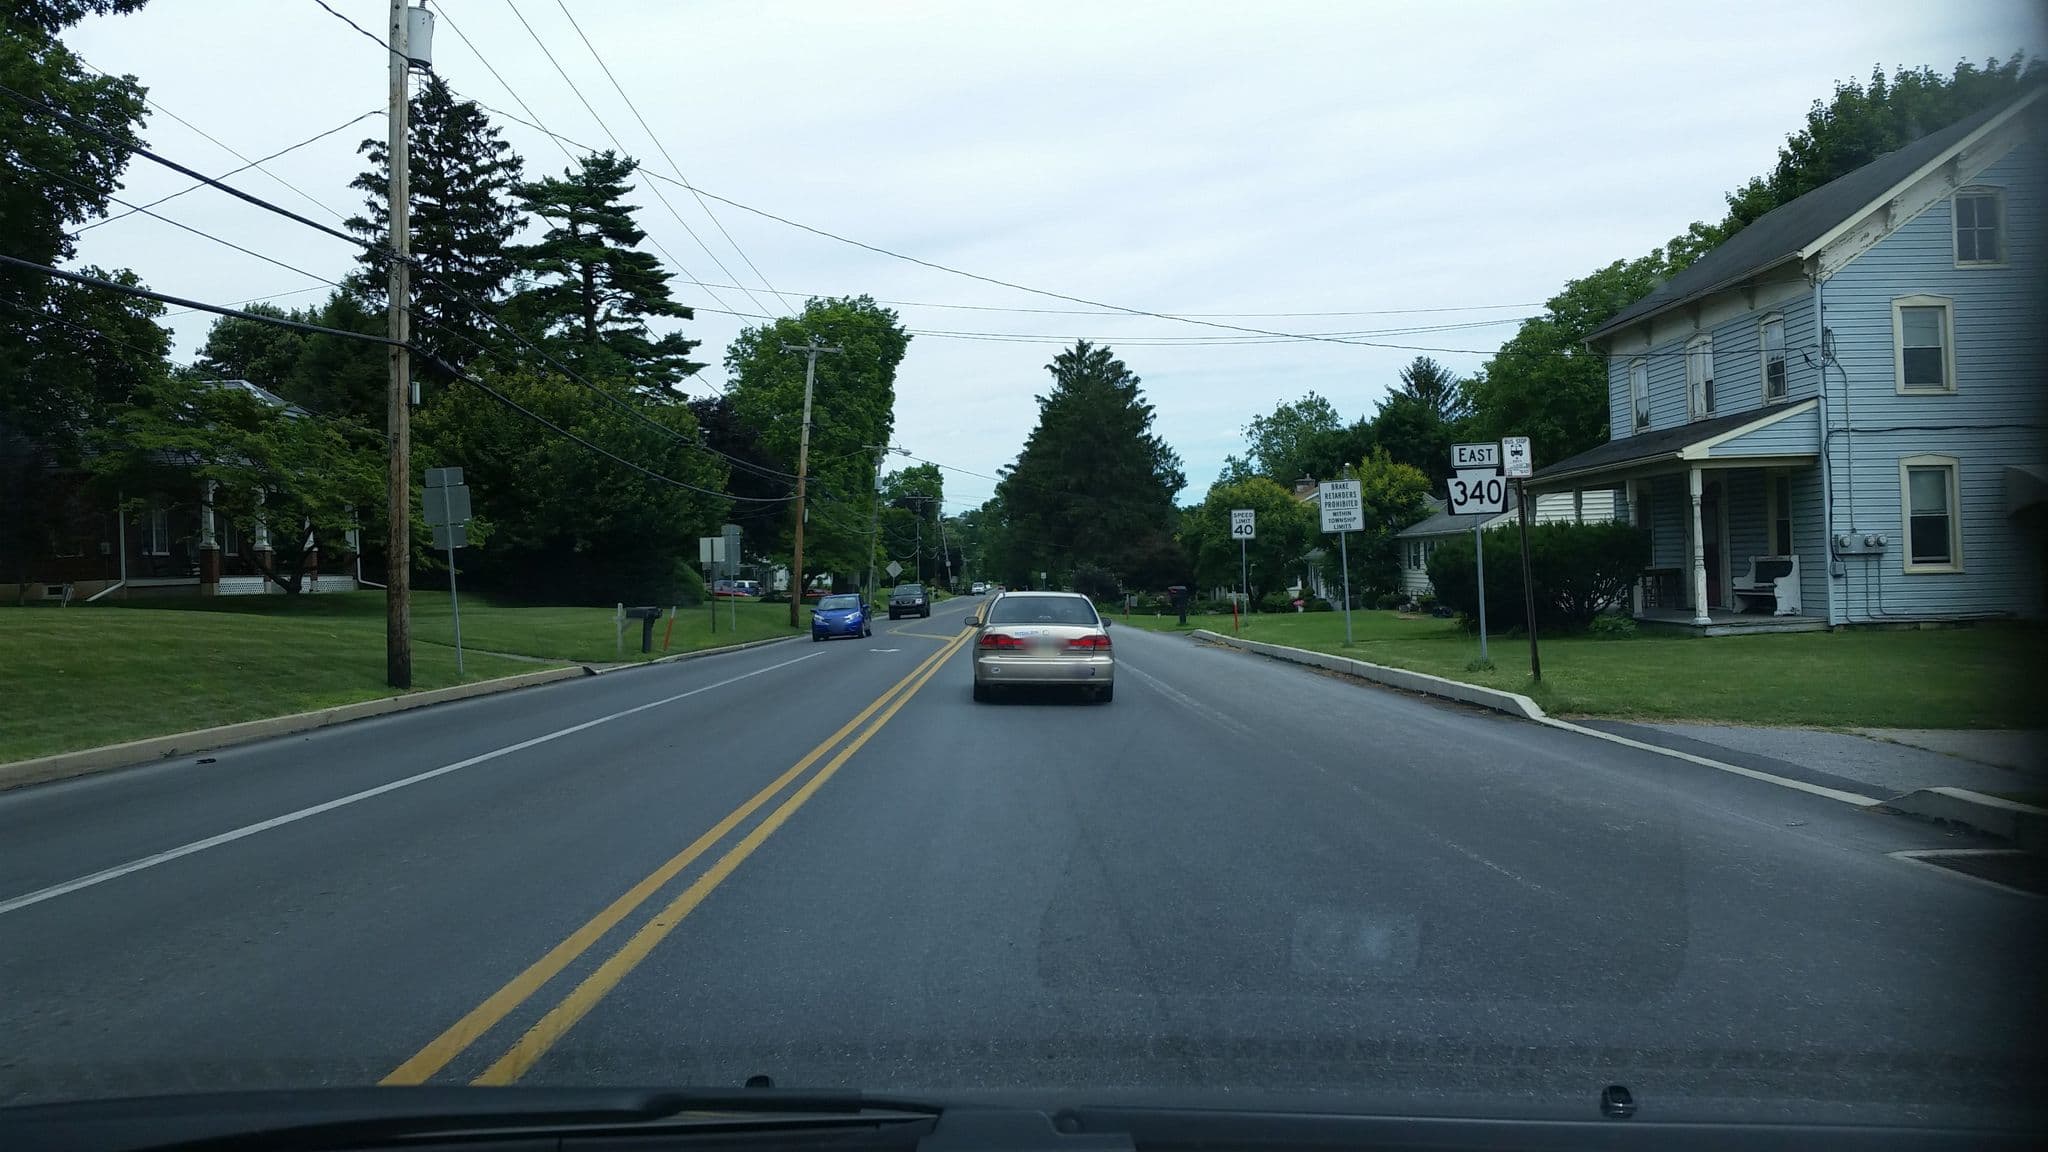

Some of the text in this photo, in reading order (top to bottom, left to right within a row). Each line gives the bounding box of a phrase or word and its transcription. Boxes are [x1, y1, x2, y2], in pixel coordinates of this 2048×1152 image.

[1459, 447, 1493, 463] EAST
[1331, 482, 1349, 490] BRAKE
[1324, 491, 1357, 500] RETARDERS
[1453, 479, 1502, 507] 340
[1324, 500, 1358, 508] PROHIBITED
[1328, 516, 1357, 524] TOWNSHIP
[1233, 524, 1253, 535] 40
